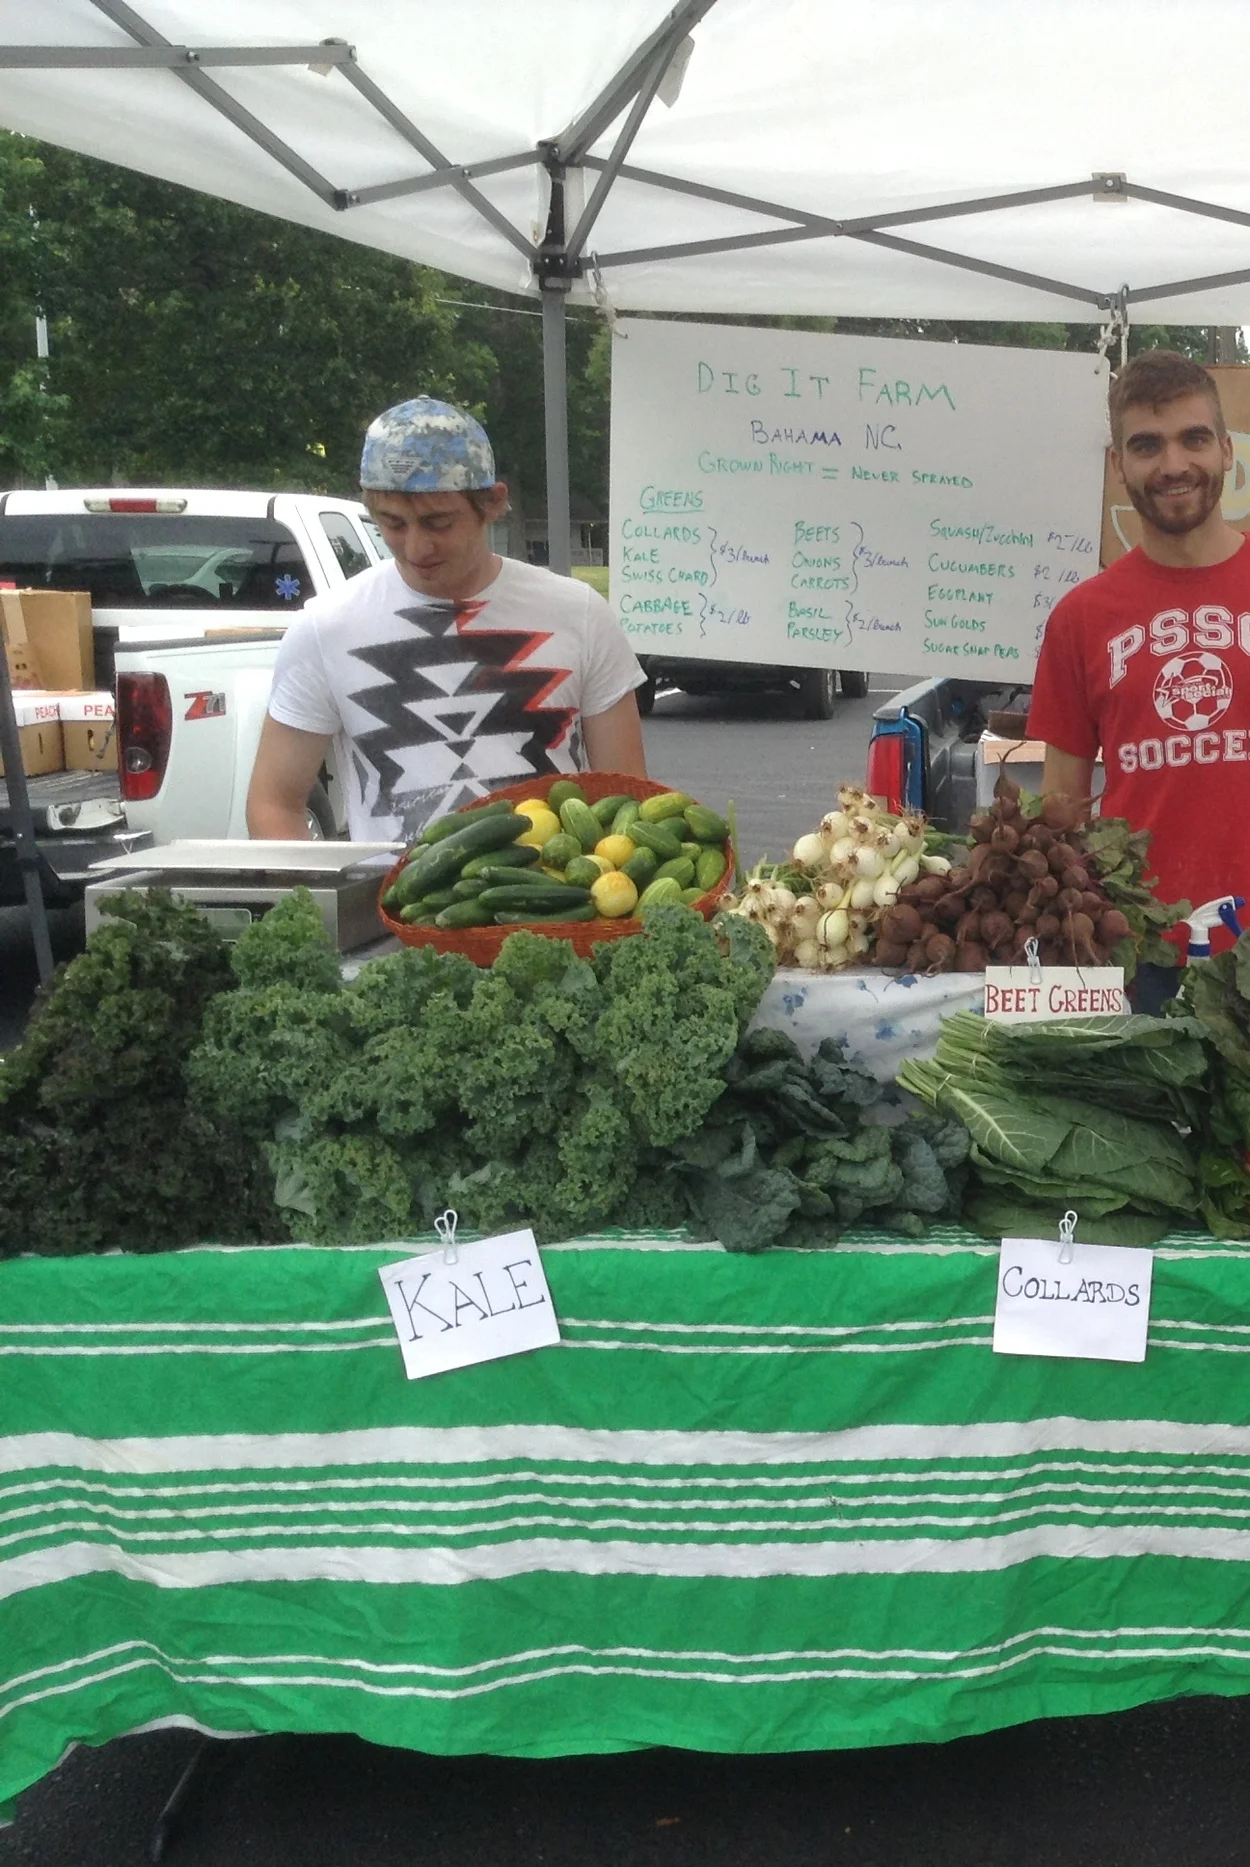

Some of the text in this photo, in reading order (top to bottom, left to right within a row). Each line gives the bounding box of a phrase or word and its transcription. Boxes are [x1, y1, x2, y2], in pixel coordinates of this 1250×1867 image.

[698, 361, 956, 411] DIG IT FARM
[751, 420, 842, 446] BAHAMA
[698, 450, 763, 474] GROWN
[770, 451, 815, 475] RIGHT
[852, 466, 899, 482] NEVER
[912, 471, 974, 489] SPRAYED
[640, 486, 703, 511] GREENS
[622, 518, 701, 544] COLLARDS
[795, 520, 840, 544] BEETS
[623, 546, 660, 563] KALE
[792, 551, 841, 571] ONIONS
[928, 553, 1015, 579] CUCUMBERS
[621, 565, 708, 586] SWISS CHARD
[791, 574, 850, 591] CARROTS
[620, 594, 693, 617] CABBAGE
[928, 584, 994, 605] EGGPLANT
[789, 601, 832, 619] BASIL
[620, 617, 683, 635] POTATOES
[787, 621, 843, 642] PARSLEY
[923, 637, 958, 656] SUGAR
[993, 643, 1019, 659] PEAS
[84, 704, 115, 717] PEA
[184, 691, 226, 721] Z71
[986, 984, 1122, 1013] BEET GREENS
[1003, 1266, 1140, 1306] COLLARDS
[394, 1259, 545, 1342] KALE
